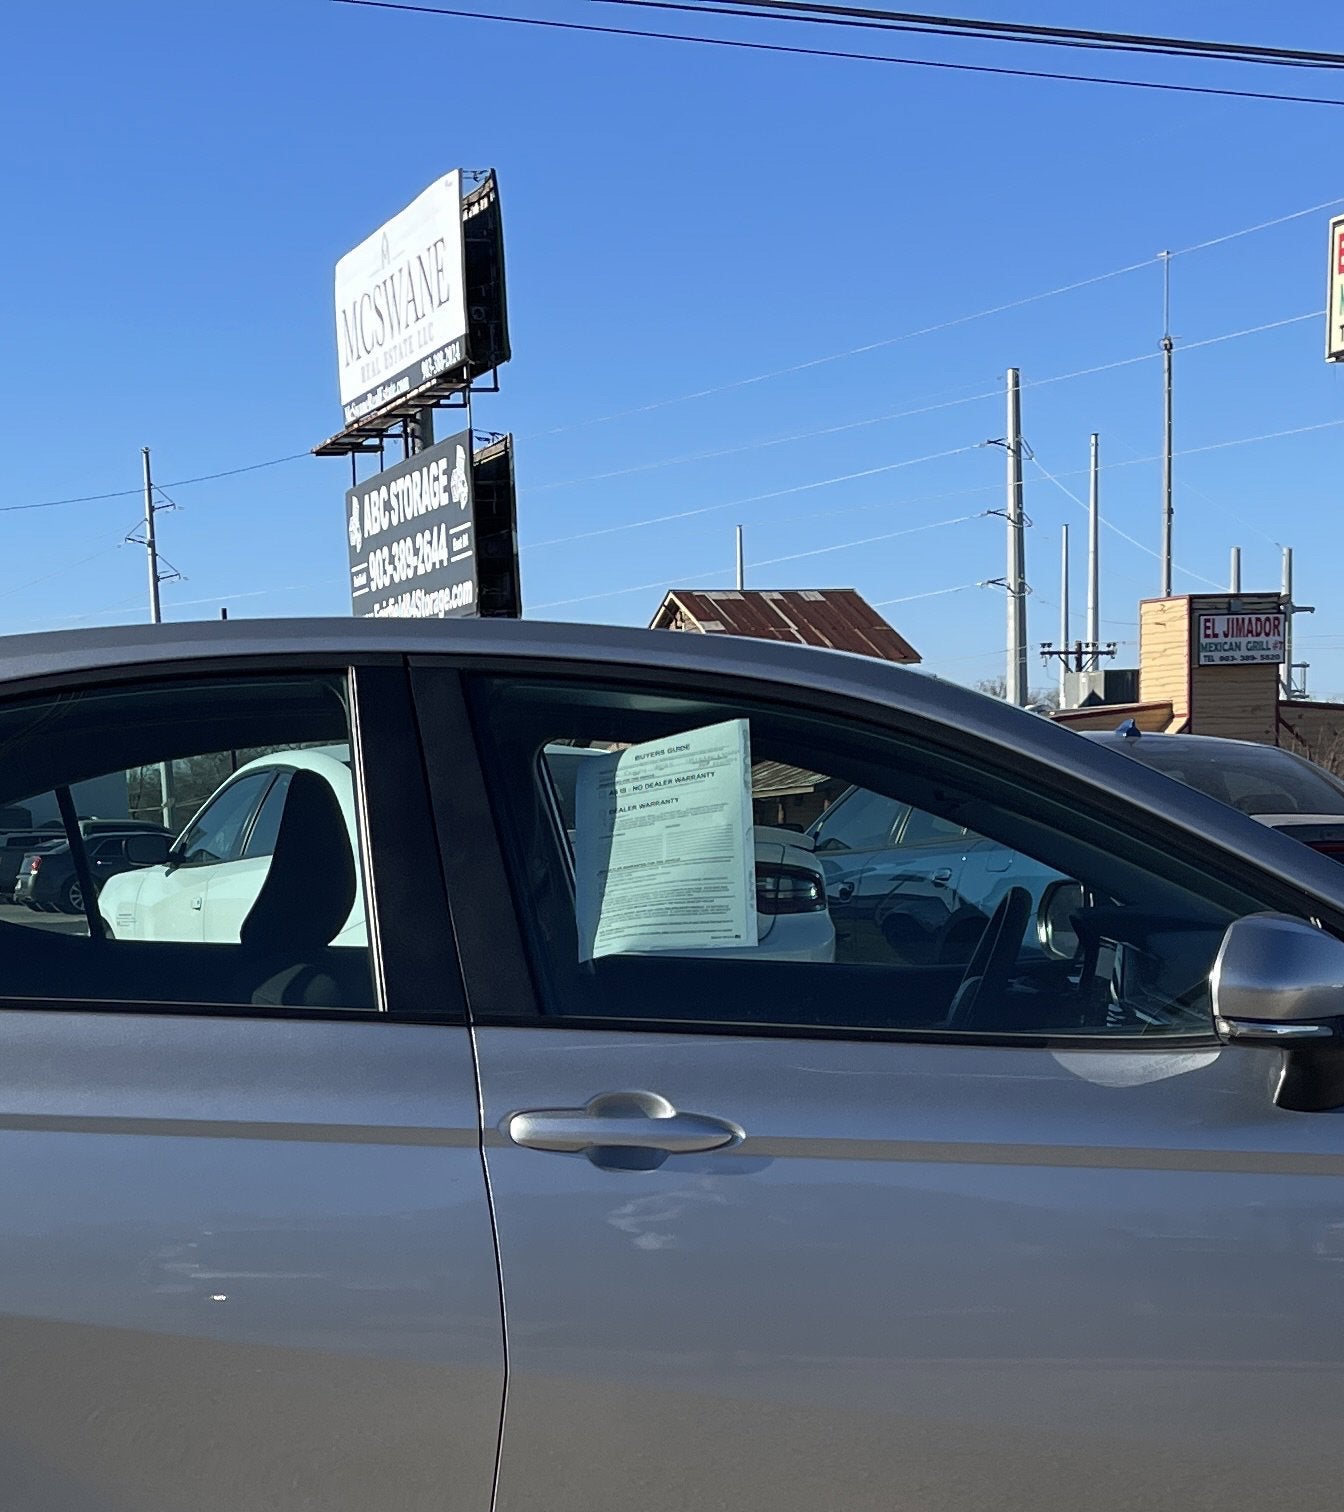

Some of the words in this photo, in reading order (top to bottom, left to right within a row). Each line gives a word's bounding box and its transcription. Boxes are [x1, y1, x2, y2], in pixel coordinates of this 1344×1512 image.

[342, 237, 450, 368] MCSWANE
[363, 485, 389, 538] ABC
[390, 457, 449, 527] STORAGE
[368, 523, 448, 592] 903-389-2644
[1203, 618, 1219, 639] EL
[1223, 616, 1281, 638] JIMADOR
[1200, 641, 1242, 653] MEXICAN
[1246, 640, 1271, 651] GRILL
[644, 778, 673, 790] DEALER
[674, 771, 716, 784] WARRANTY
[639, 797, 679, 809] WARRANTY
